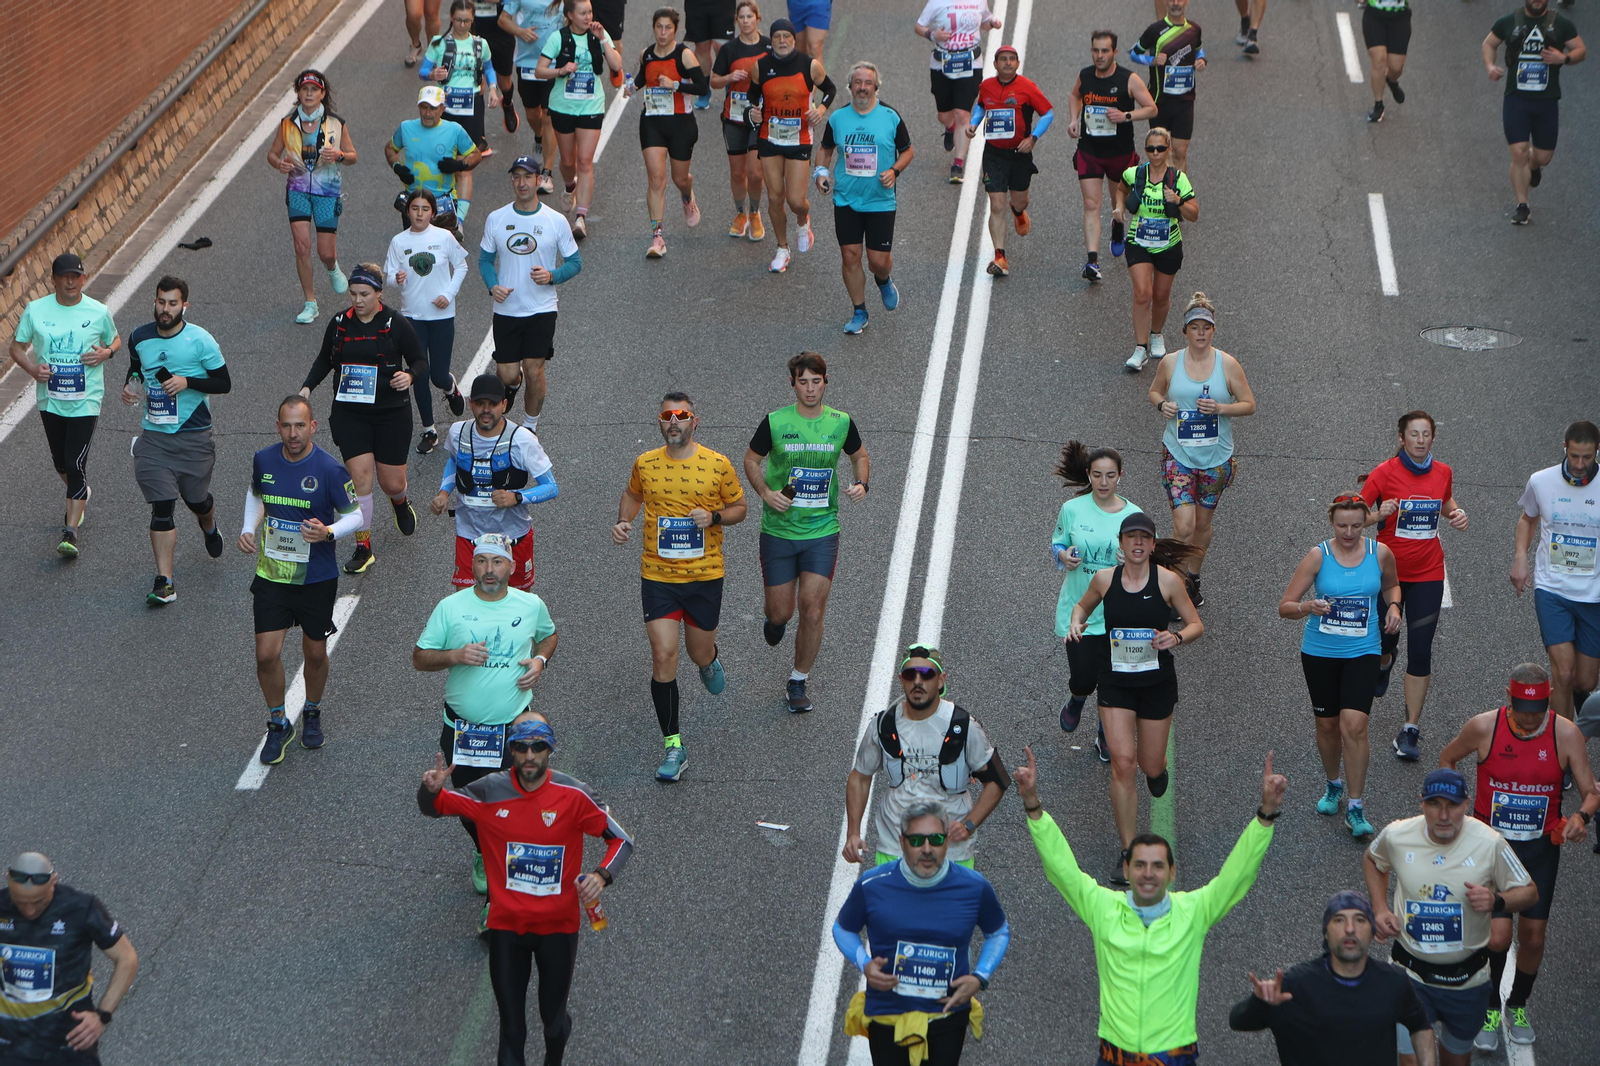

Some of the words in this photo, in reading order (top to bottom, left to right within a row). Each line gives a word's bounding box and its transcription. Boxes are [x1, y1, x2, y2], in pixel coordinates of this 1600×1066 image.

[856, 133, 875, 143] TRAIL
[350, 367, 372, 375] ZURICH
[785, 443, 805, 452] MEDIO
[805, 442, 835, 452] MARATÓN
[280, 522, 302, 531] ZURIC
[279, 536, 294, 544] 8812
[671, 533, 690, 541] 11431
[1566, 537, 1591, 546] ZURICH
[1564, 550, 1580, 559] 8972
[1126, 631, 1153, 639] ZURICH
[1125, 646, 1144, 654] 11202
[474, 749, 500, 757] MARTINS
[1426, 782, 1457, 795] UTMB
[1489, 776, 1510, 791] Los
[1511, 781, 1554, 793] Lentos
[1511, 797, 1542, 806] ZURICH
[1508, 812, 1531, 821] 11512
[1498, 820, 1512, 829] DON
[1511, 821, 1538, 831] ANTONIO
[514, 871, 540, 884] ALBERTO
[540, 874, 556, 885] JOSÉ
[1423, 905, 1454, 914] ZURICH
[1421, 922, 1445, 932] 12463
[1421, 933, 1445, 942] KLITON
[15, 950, 47, 962] ZURICH
[917, 948, 949, 960] ZURICH
[913, 965, 937, 976] 11460
[897, 973, 918, 986] LUCHA
[918, 976, 934, 987] VIVE
[933, 978, 948, 988] AMA
